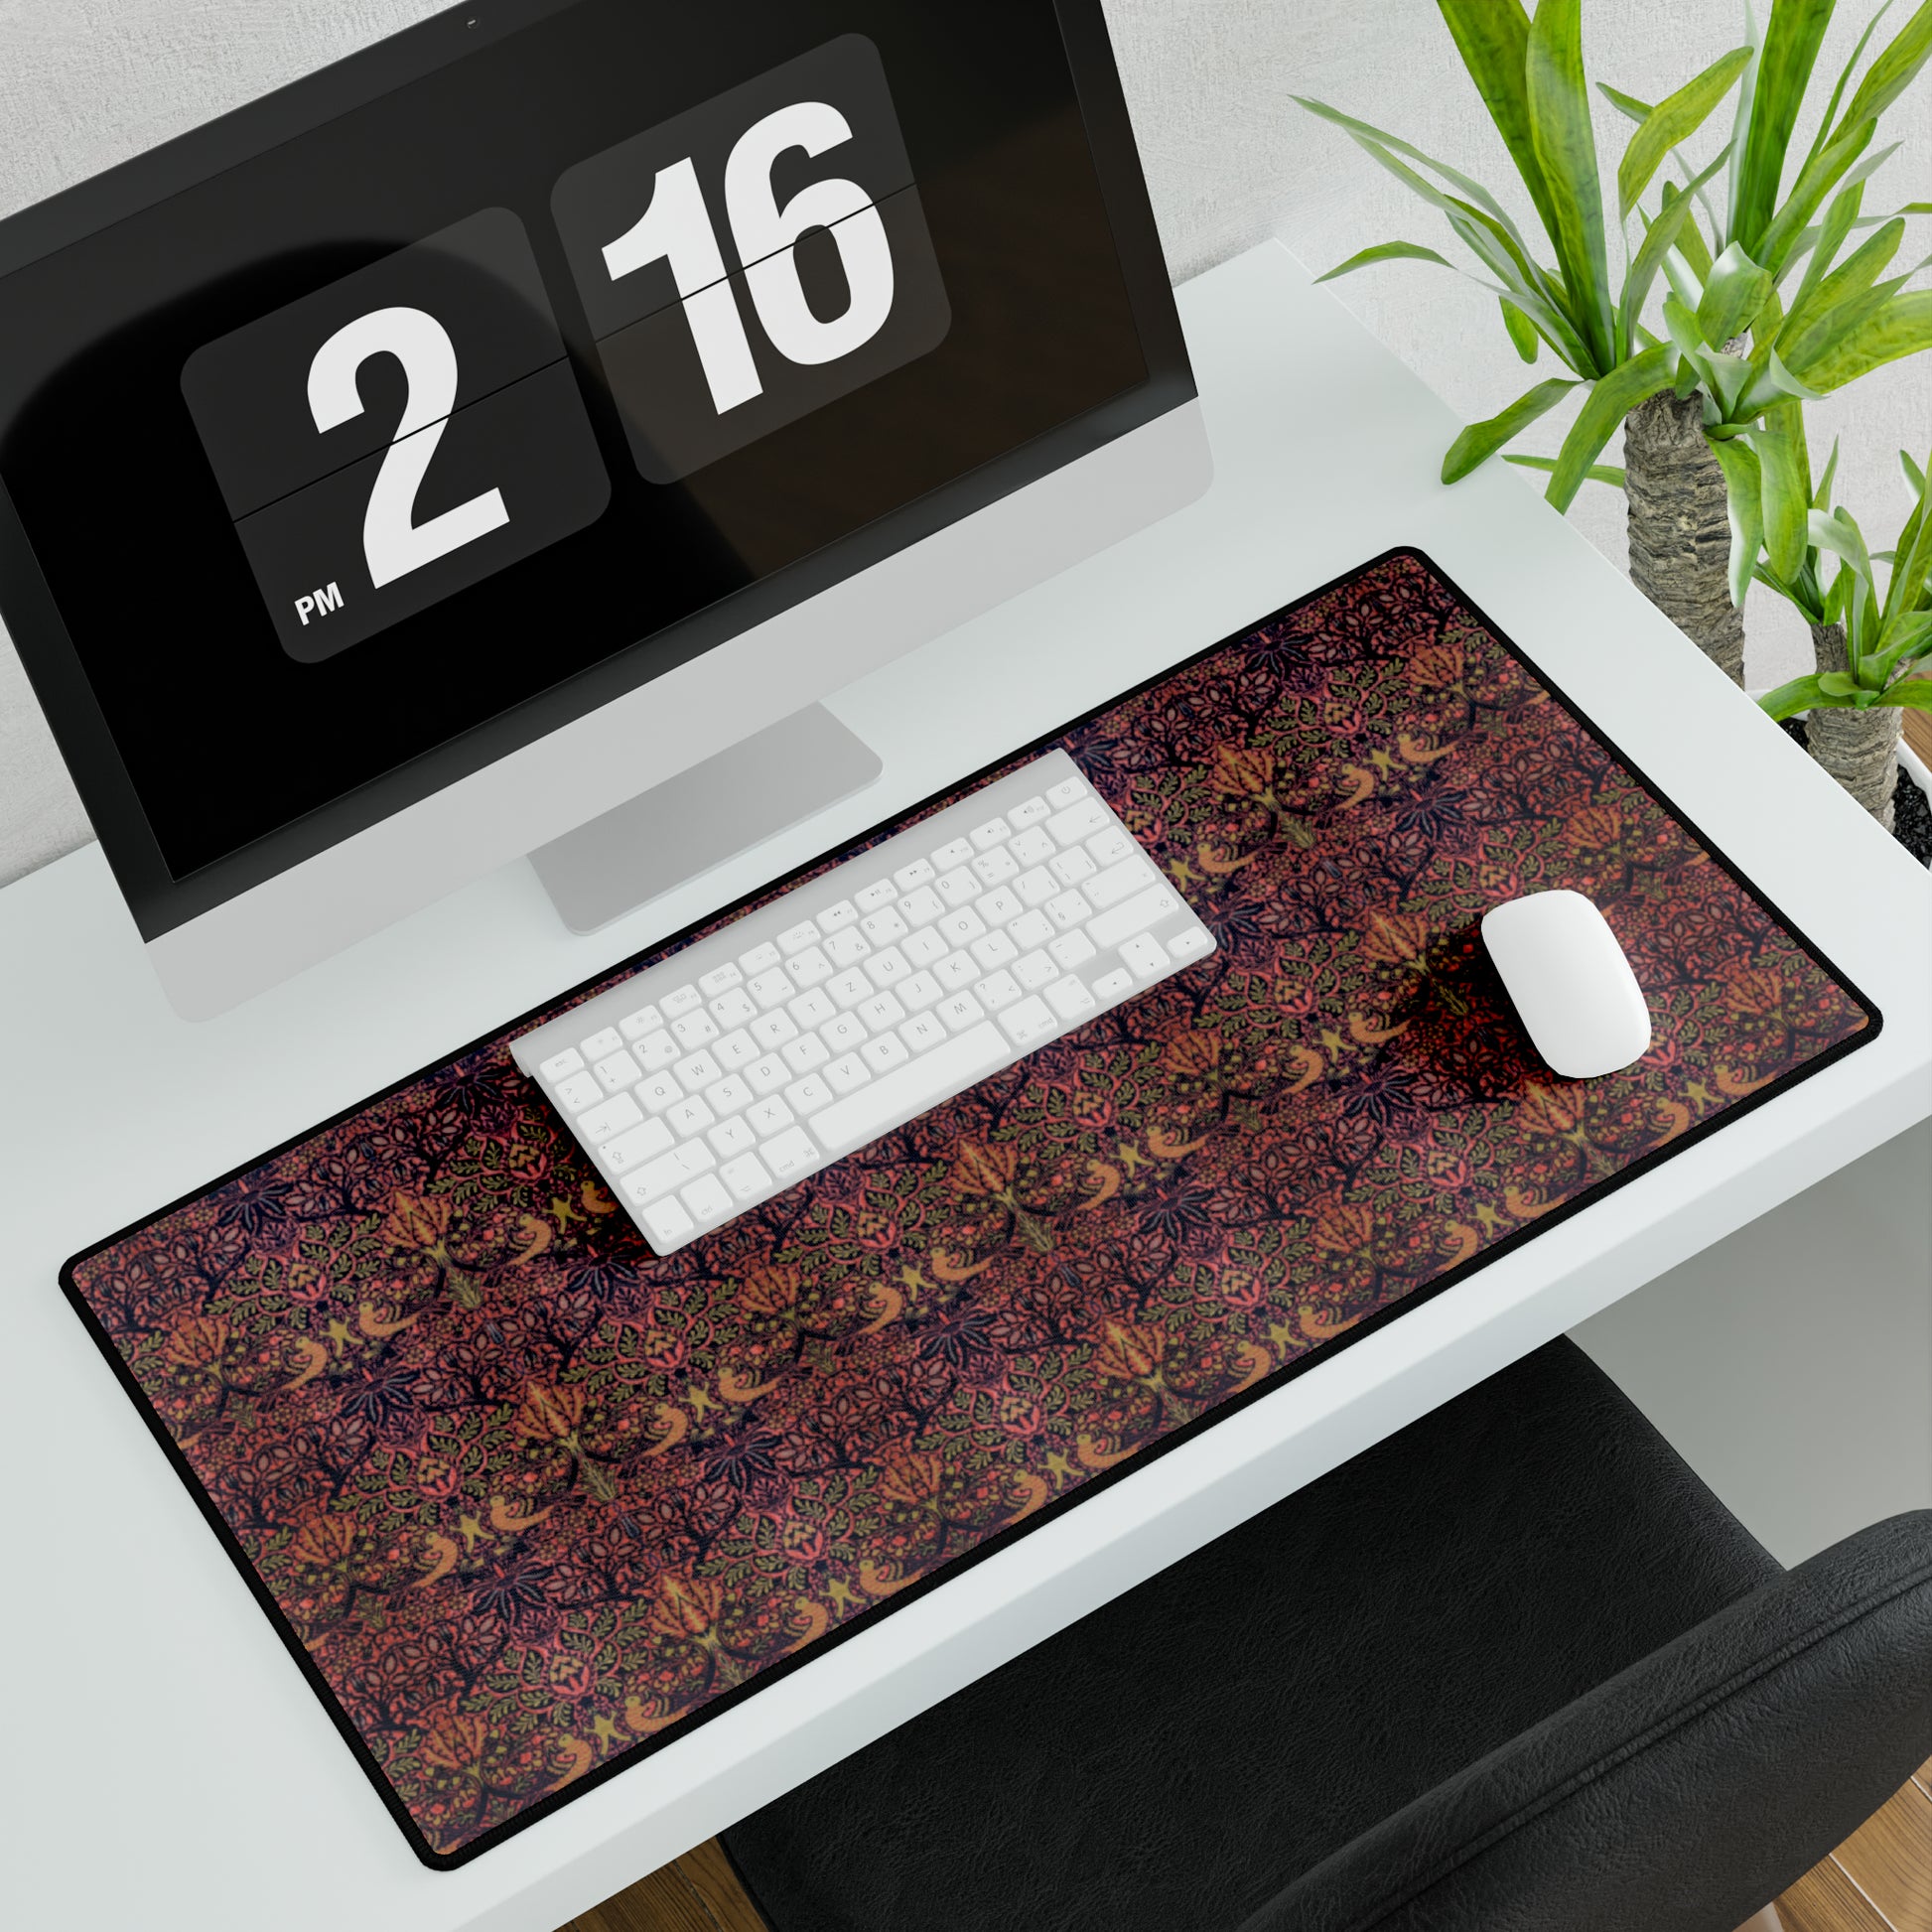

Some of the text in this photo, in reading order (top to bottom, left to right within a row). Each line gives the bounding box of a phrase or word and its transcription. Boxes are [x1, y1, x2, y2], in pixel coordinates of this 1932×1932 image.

[308, 101, 894, 589] 2 16
[295, 582, 344, 625] PM
[638, 1044, 648, 1054] 2
[677, 1024, 687, 1034] 3
[754, 981, 762, 992] 5
[792, 961, 800, 971] 6
[828, 940, 836, 951] 7
[866, 920, 876, 930] 8
[903, 900, 911, 910] 9
[654, 1086, 666, 1097] Q
[690, 1063, 706, 1076] W
[732, 1043, 742, 1055] E
[769, 1024, 781, 1034] R
[807, 1003, 817, 1013] T
[845, 981, 857, 993] Z
[882, 961, 894, 972] U
[995, 900, 1004, 911] P
[685, 1108, 695, 1120] A
[722, 1087, 733, 1098] S
[759, 1066, 771, 1077] D
[798, 1044, 807, 1055] F
[836, 1024, 848, 1035] G
[874, 1003, 887, 1015] H
[914, 983, 922, 994] J
[949, 961, 962, 973] K
[987, 943, 999, 952] L
[725, 1128, 735, 1140] Y
[762, 1107, 776, 1119] X
[802, 1086, 814, 1097] C
[840, 1064, 851, 1076] V
[878, 1044, 890, 1056] B
[915, 1023, 928, 1035] N
[953, 1003, 968, 1015] M
